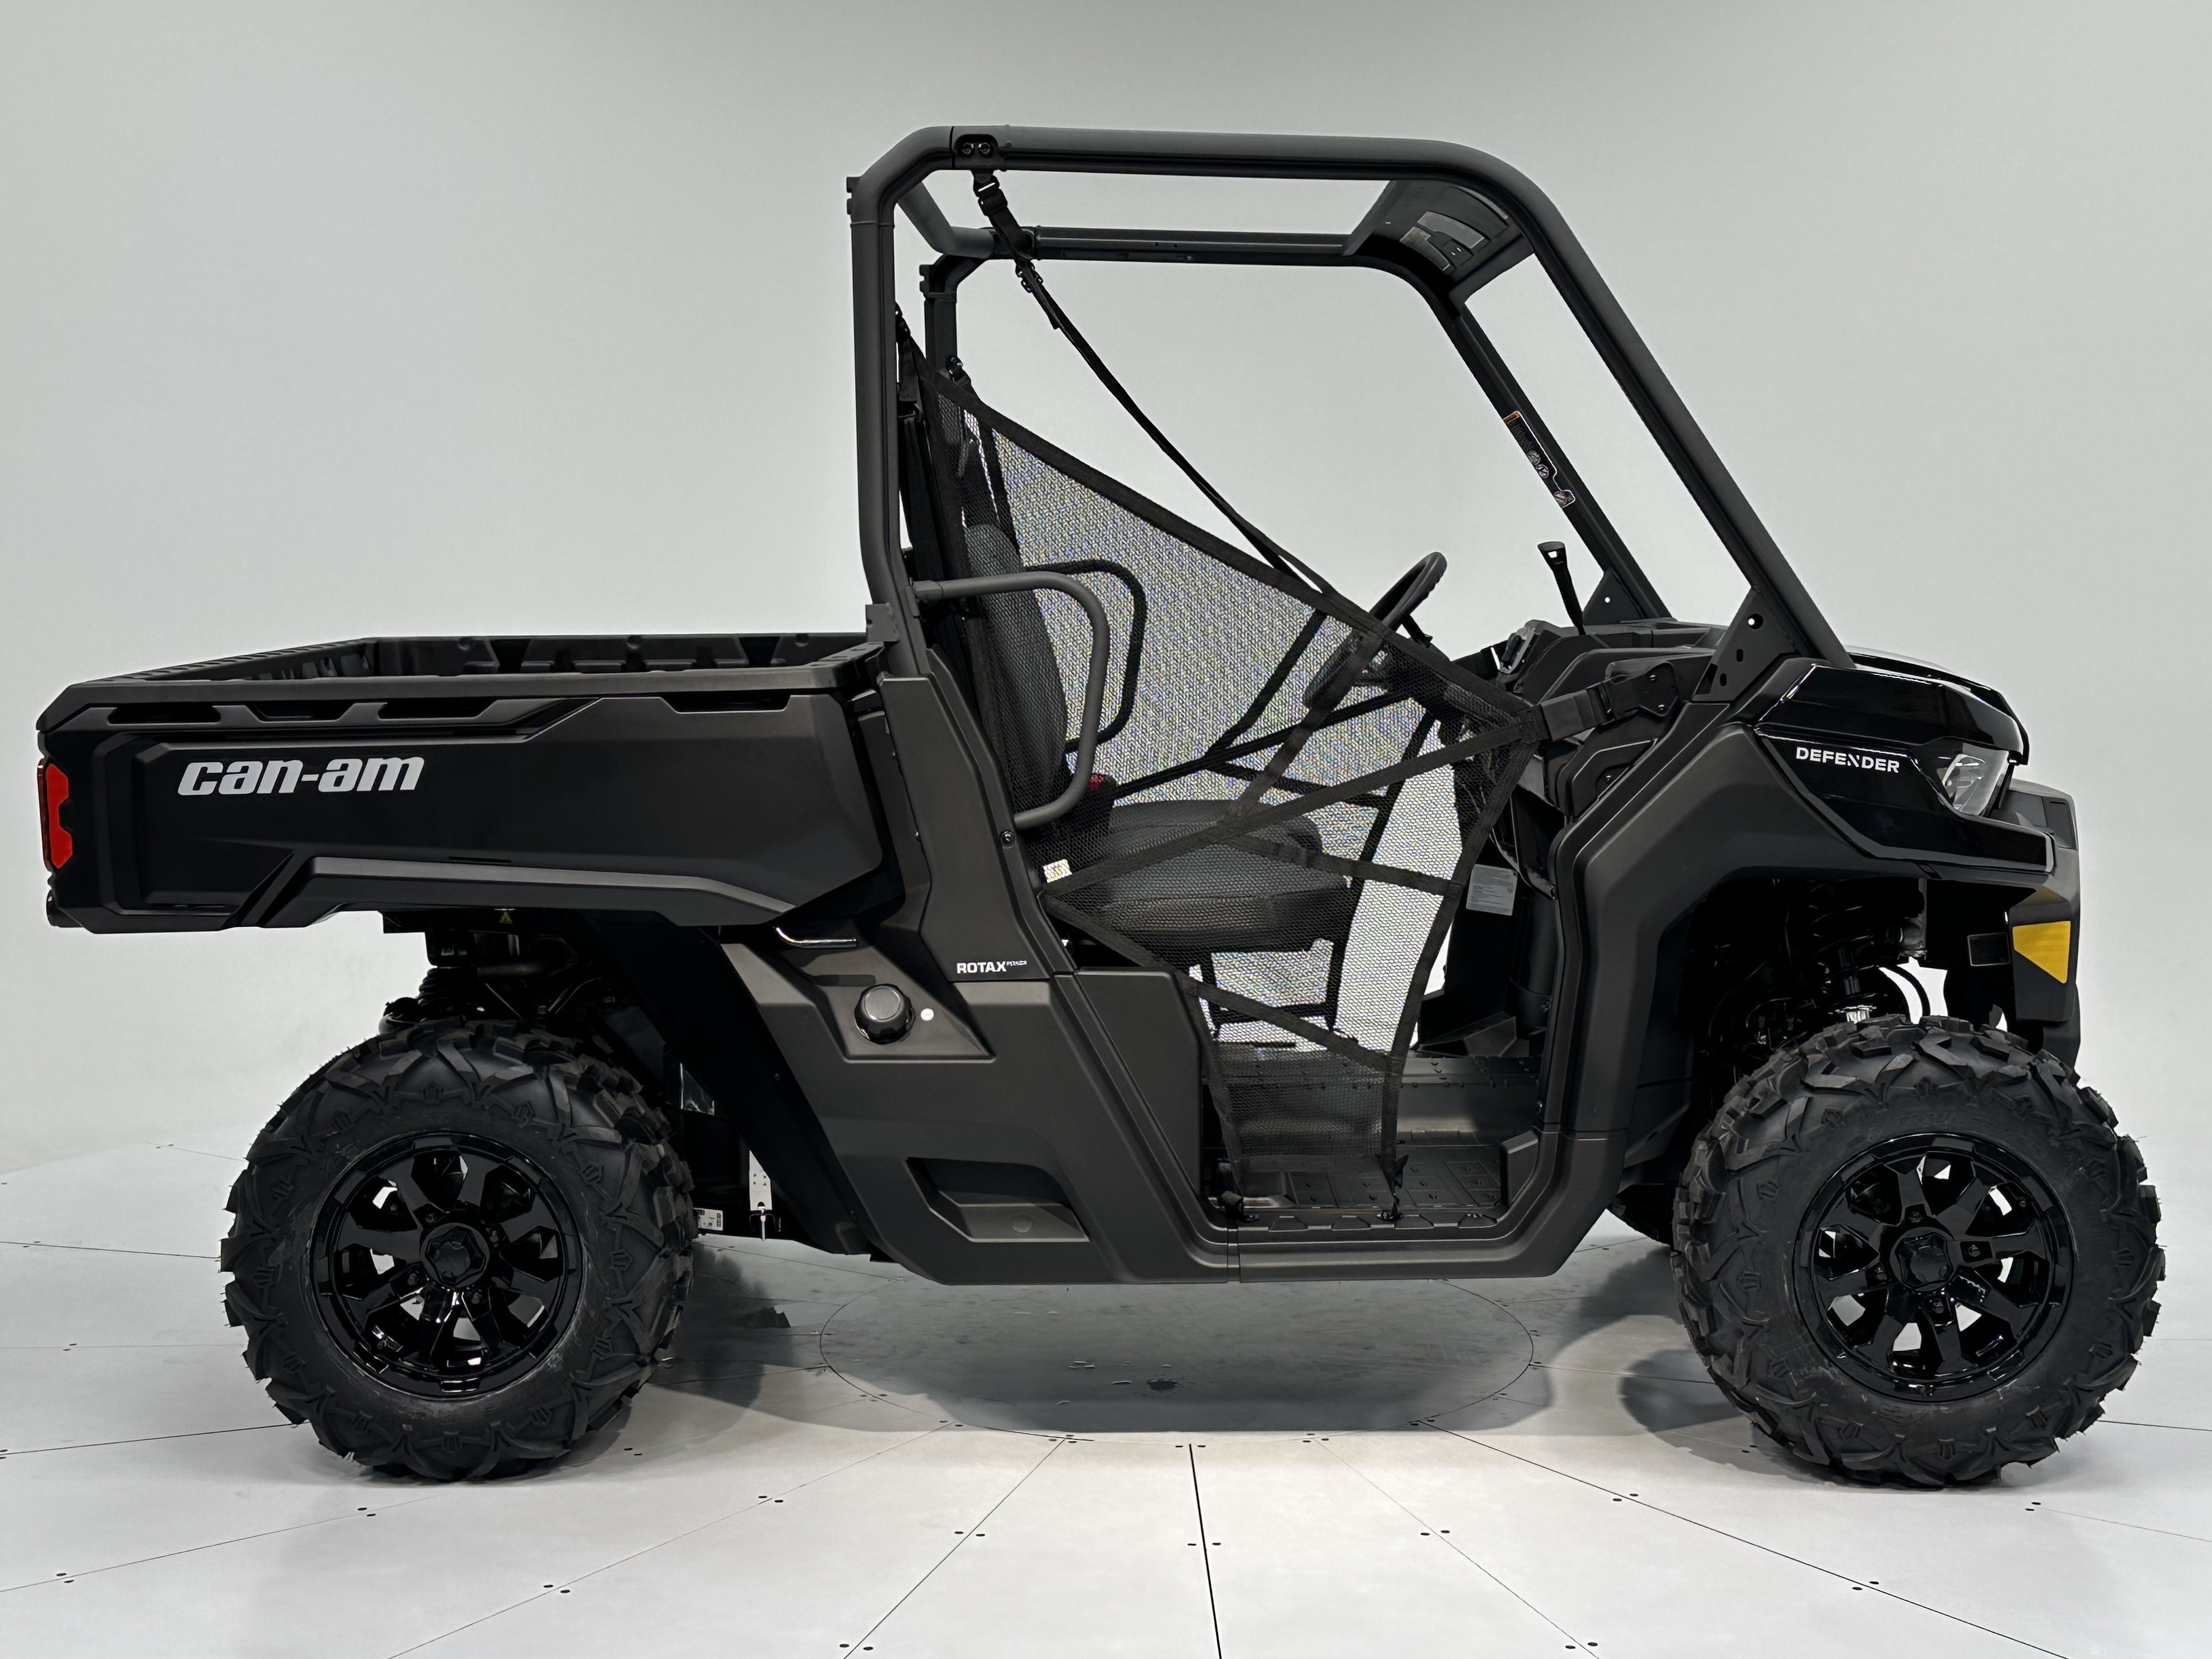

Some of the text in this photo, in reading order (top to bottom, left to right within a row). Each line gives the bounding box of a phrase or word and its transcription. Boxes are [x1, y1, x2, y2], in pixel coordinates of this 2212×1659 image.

[1796, 747, 1900, 773] DEFENDER
[178, 756, 425, 796] can-am
[957, 961, 1007, 974] ROTAX
